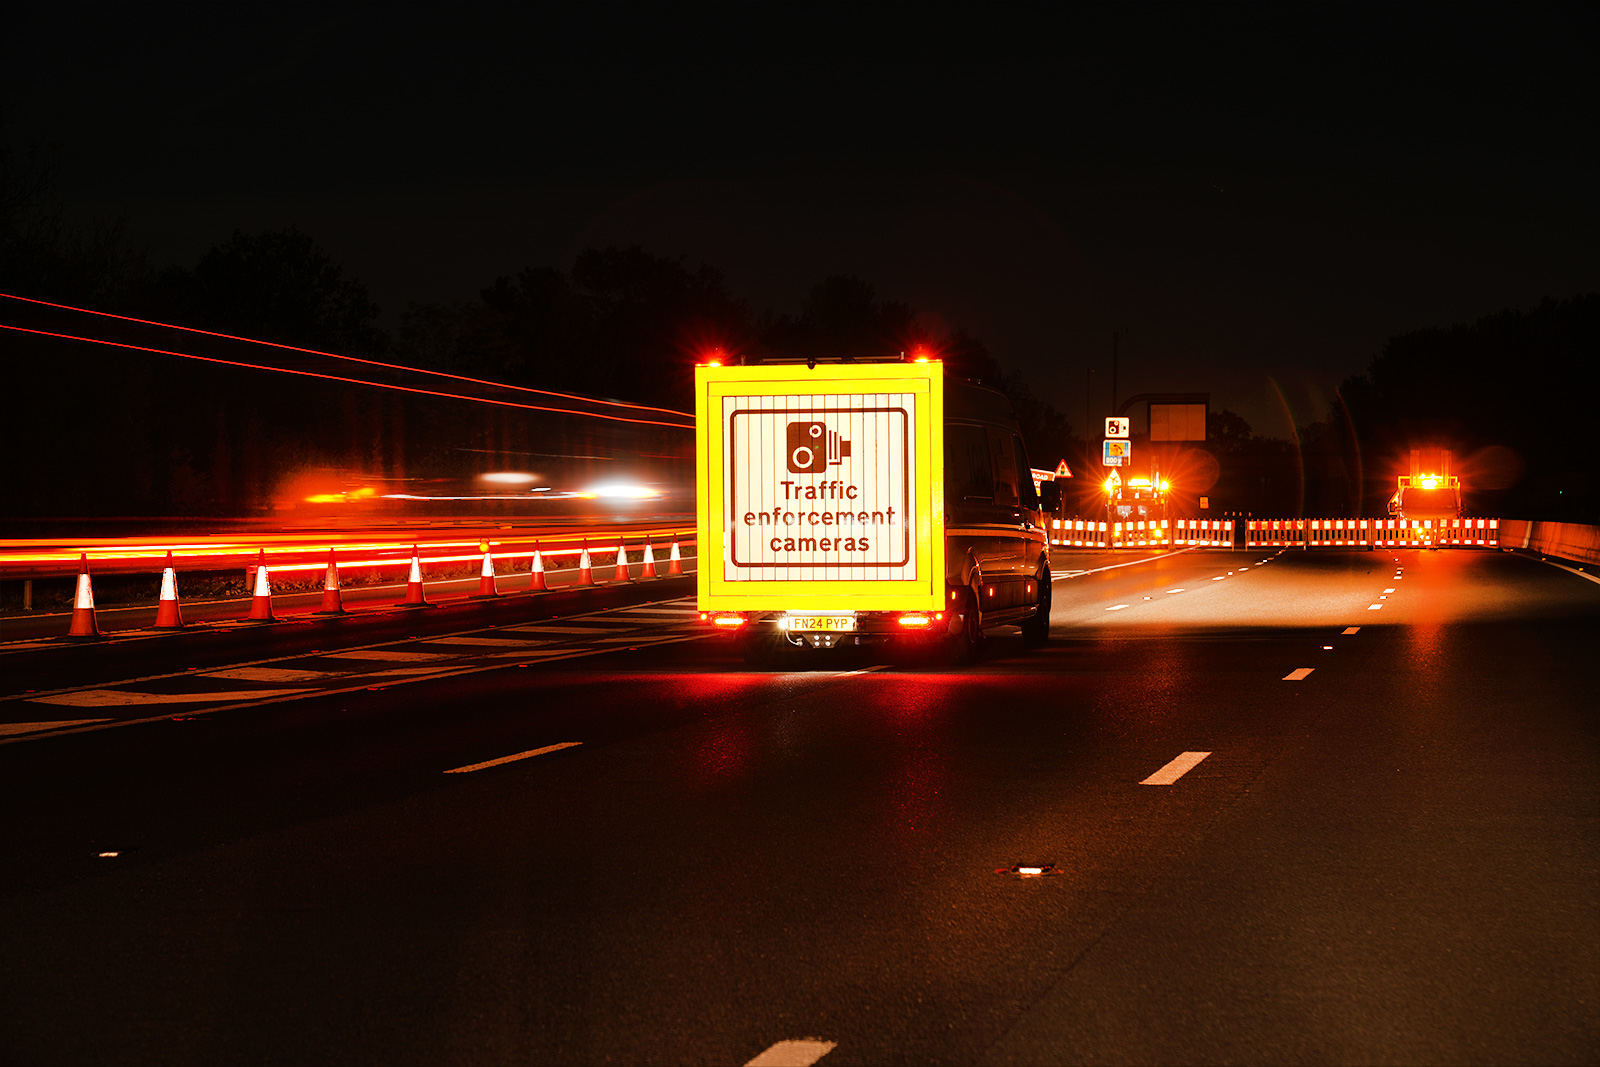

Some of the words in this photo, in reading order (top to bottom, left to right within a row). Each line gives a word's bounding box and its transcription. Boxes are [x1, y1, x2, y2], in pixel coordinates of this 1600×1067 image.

[780, 480, 858, 500] Traffic
[743, 506, 896, 526] enforcement
[770, 536, 870, 552] cameras
[794, 618, 823, 629] FN24
[826, 618, 848, 629] PYP
